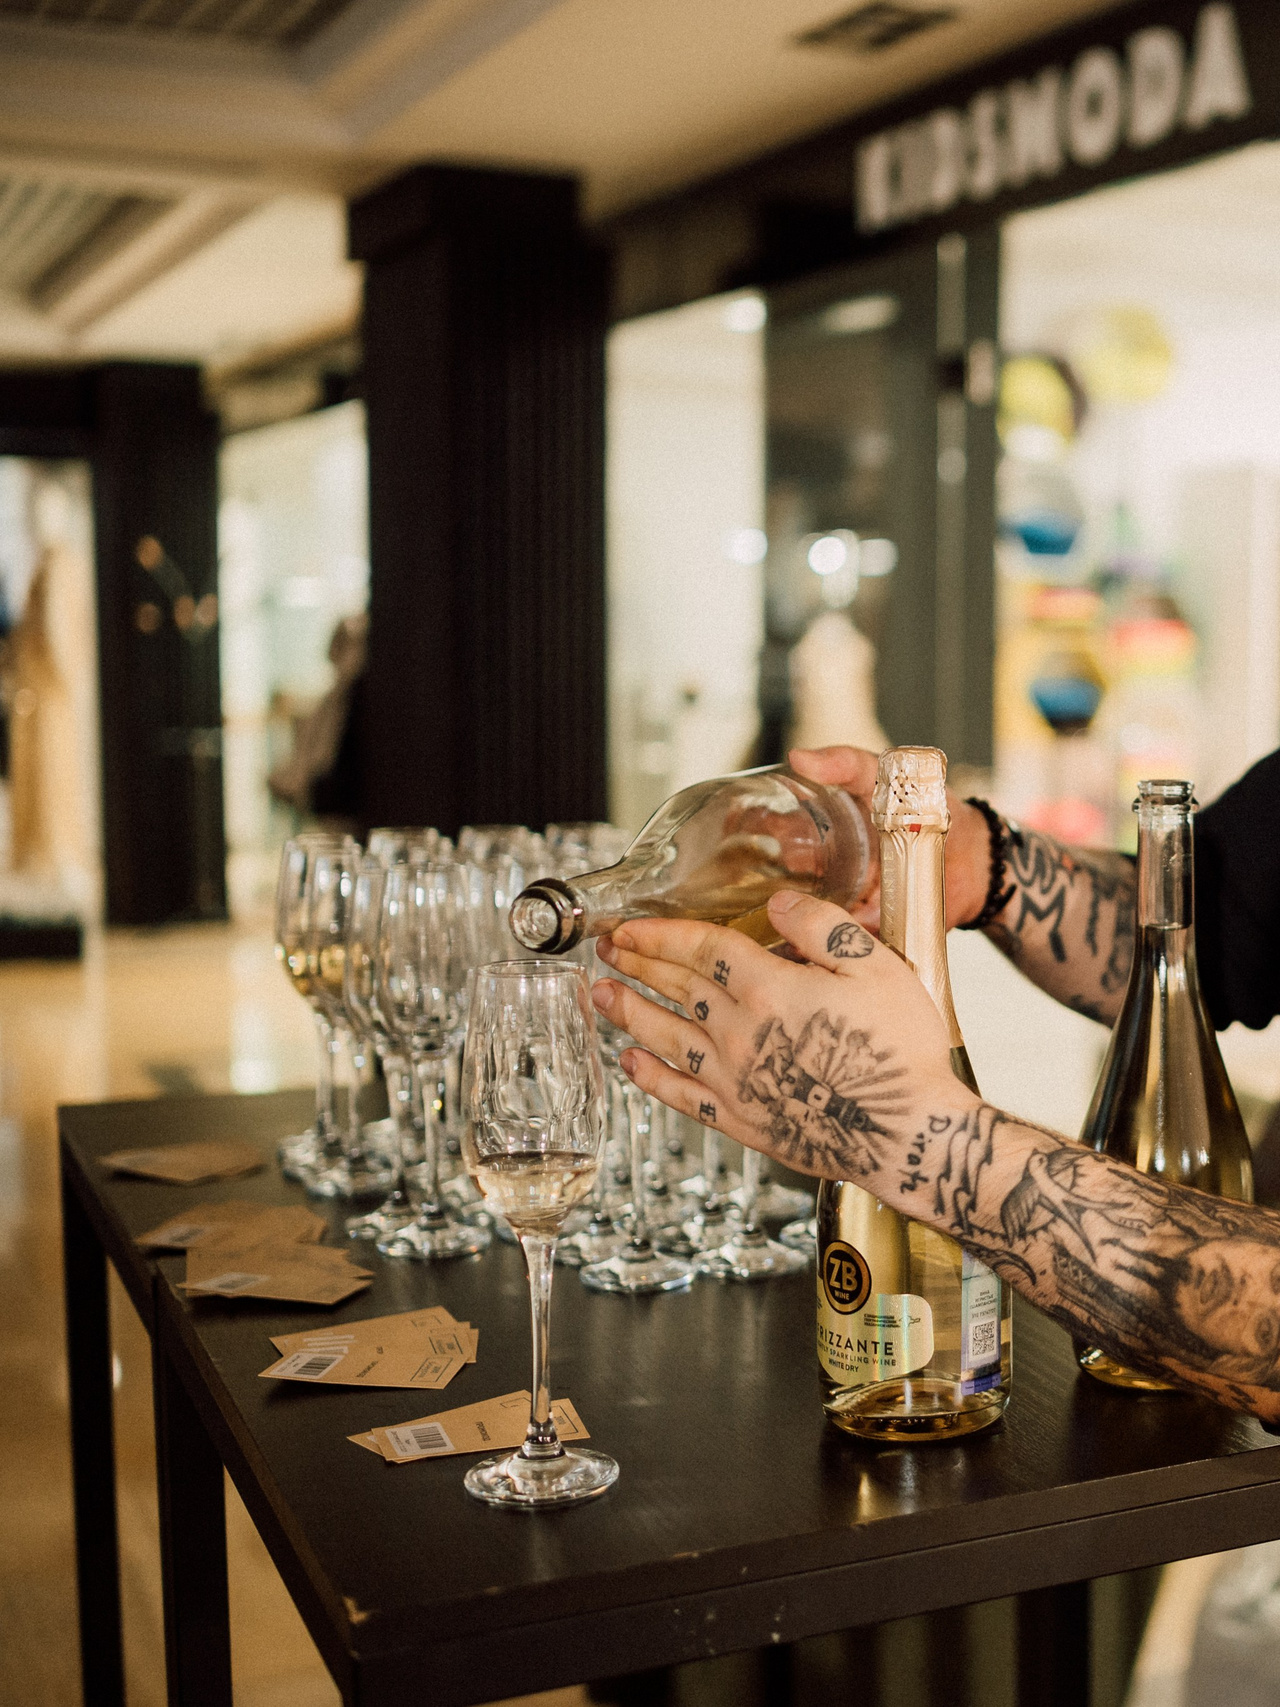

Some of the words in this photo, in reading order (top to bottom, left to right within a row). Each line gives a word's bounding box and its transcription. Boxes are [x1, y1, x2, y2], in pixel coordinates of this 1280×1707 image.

[829, 1257, 858, 1291] ZB
[834, 1290, 849, 1300] WINE
[828, 1358, 845, 1370] WHITE
[845, 1364, 859, 1372] DRY
[830, 1348, 869, 1364] SPARKLING
[872, 1359, 897, 1367] WINE
